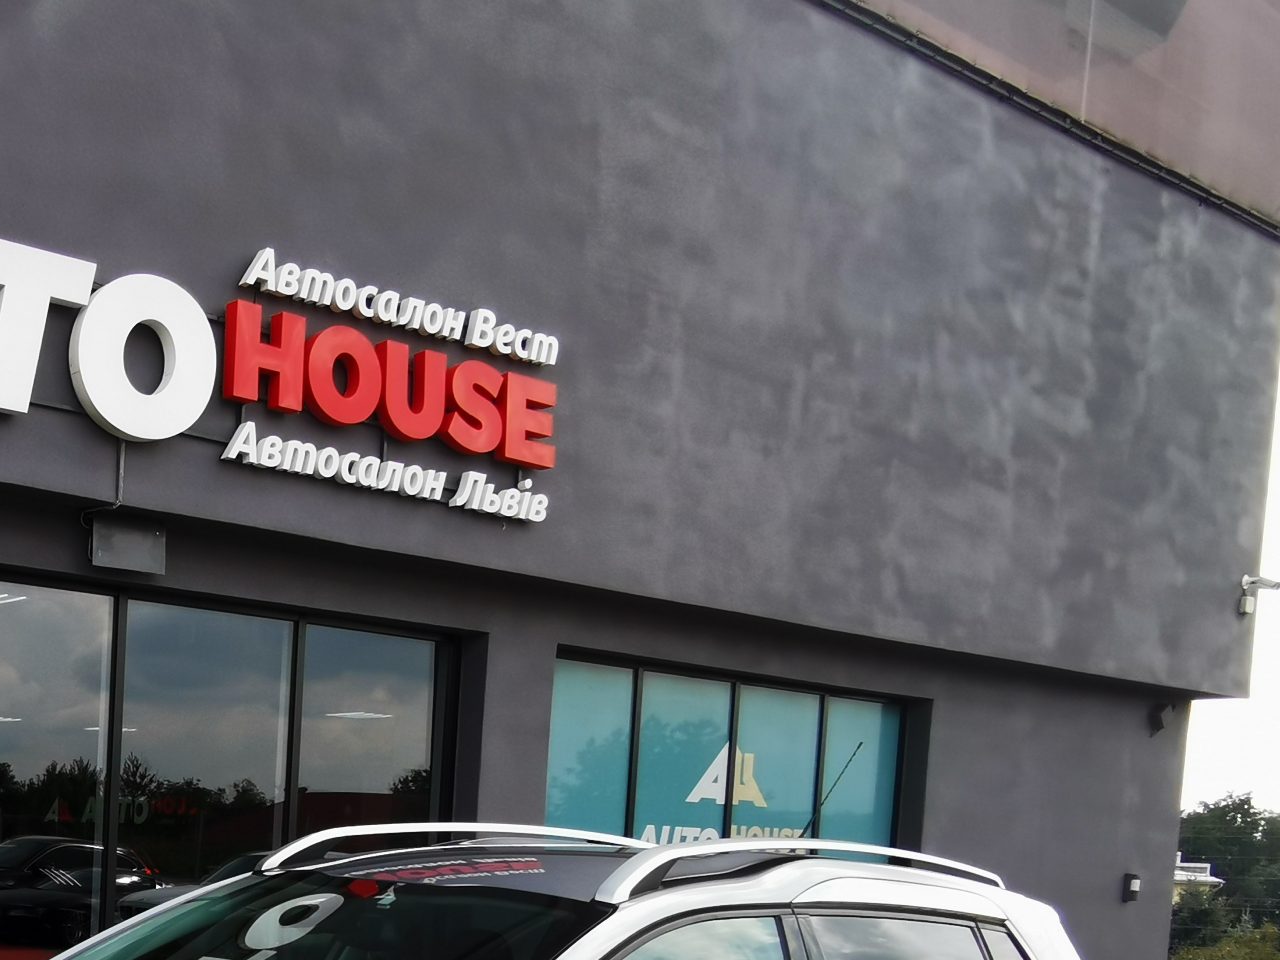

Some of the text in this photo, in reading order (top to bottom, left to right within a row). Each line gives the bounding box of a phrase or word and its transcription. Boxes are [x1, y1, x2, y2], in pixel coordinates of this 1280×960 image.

[239, 247, 559, 366] Автосалон Вест
[223, 299, 558, 470] HOUSE
[221, 421, 549, 522] Автосалон Львів
